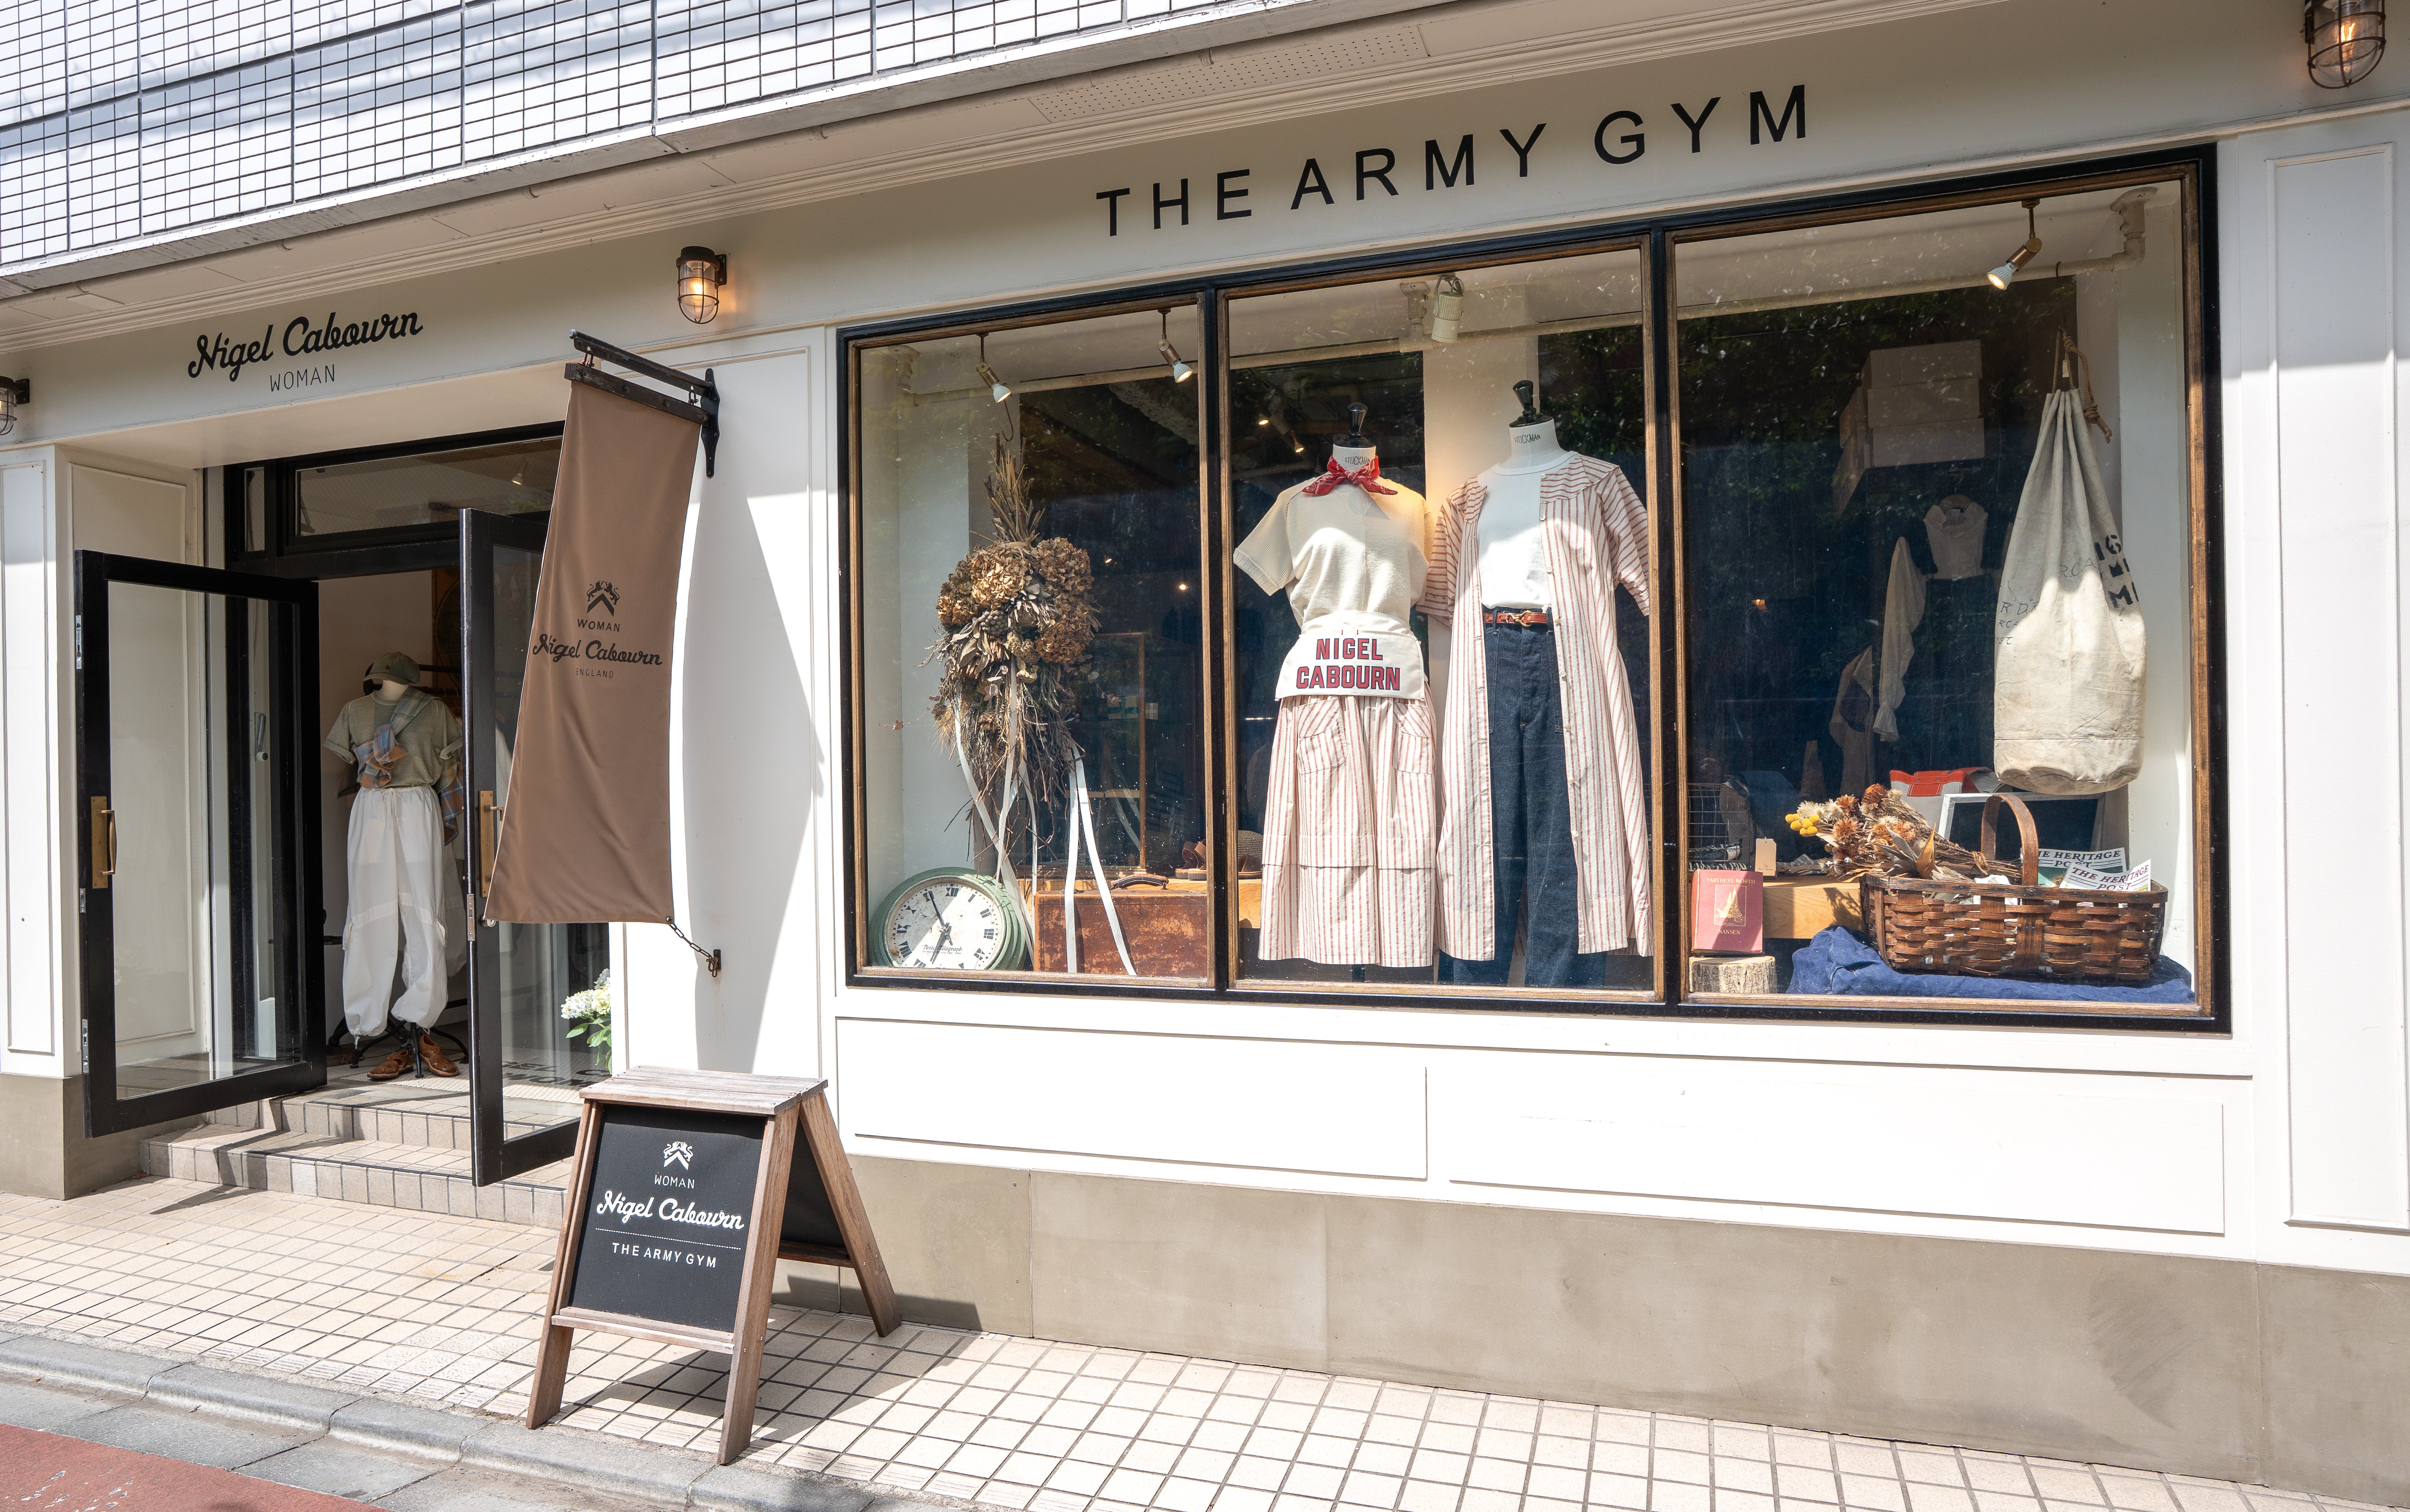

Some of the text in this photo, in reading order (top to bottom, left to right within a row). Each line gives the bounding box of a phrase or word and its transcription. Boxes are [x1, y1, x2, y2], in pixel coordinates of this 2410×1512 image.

[1095, 84, 1806, 237] THE ARMY GYM
[187, 312, 423, 382] Nigel Cabourn
[270, 364, 335, 392] WOMAN
[1514, 433, 1541, 444] STOCKMAN
[1344, 456, 1370, 465] STOCKMAN
[577, 618, 620, 632] WOMAN
[532, 633, 663, 666] Nigel Cabourn
[1316, 638, 1383, 660] NIGEL
[576, 668, 614, 678] ENGLAND
[1296, 665, 1400, 691] CABOURN
[2053, 850, 2121, 862] HERITAGE
[2071, 865, 2149, 884] THE HERITAGE
[2096, 883, 2132, 891] POST
[654, 1174, 696, 1189] WOMAN
[596, 1190, 745, 1230] Nigel Cabourn
[612, 1242, 717, 1268] THE ARMY GYM
